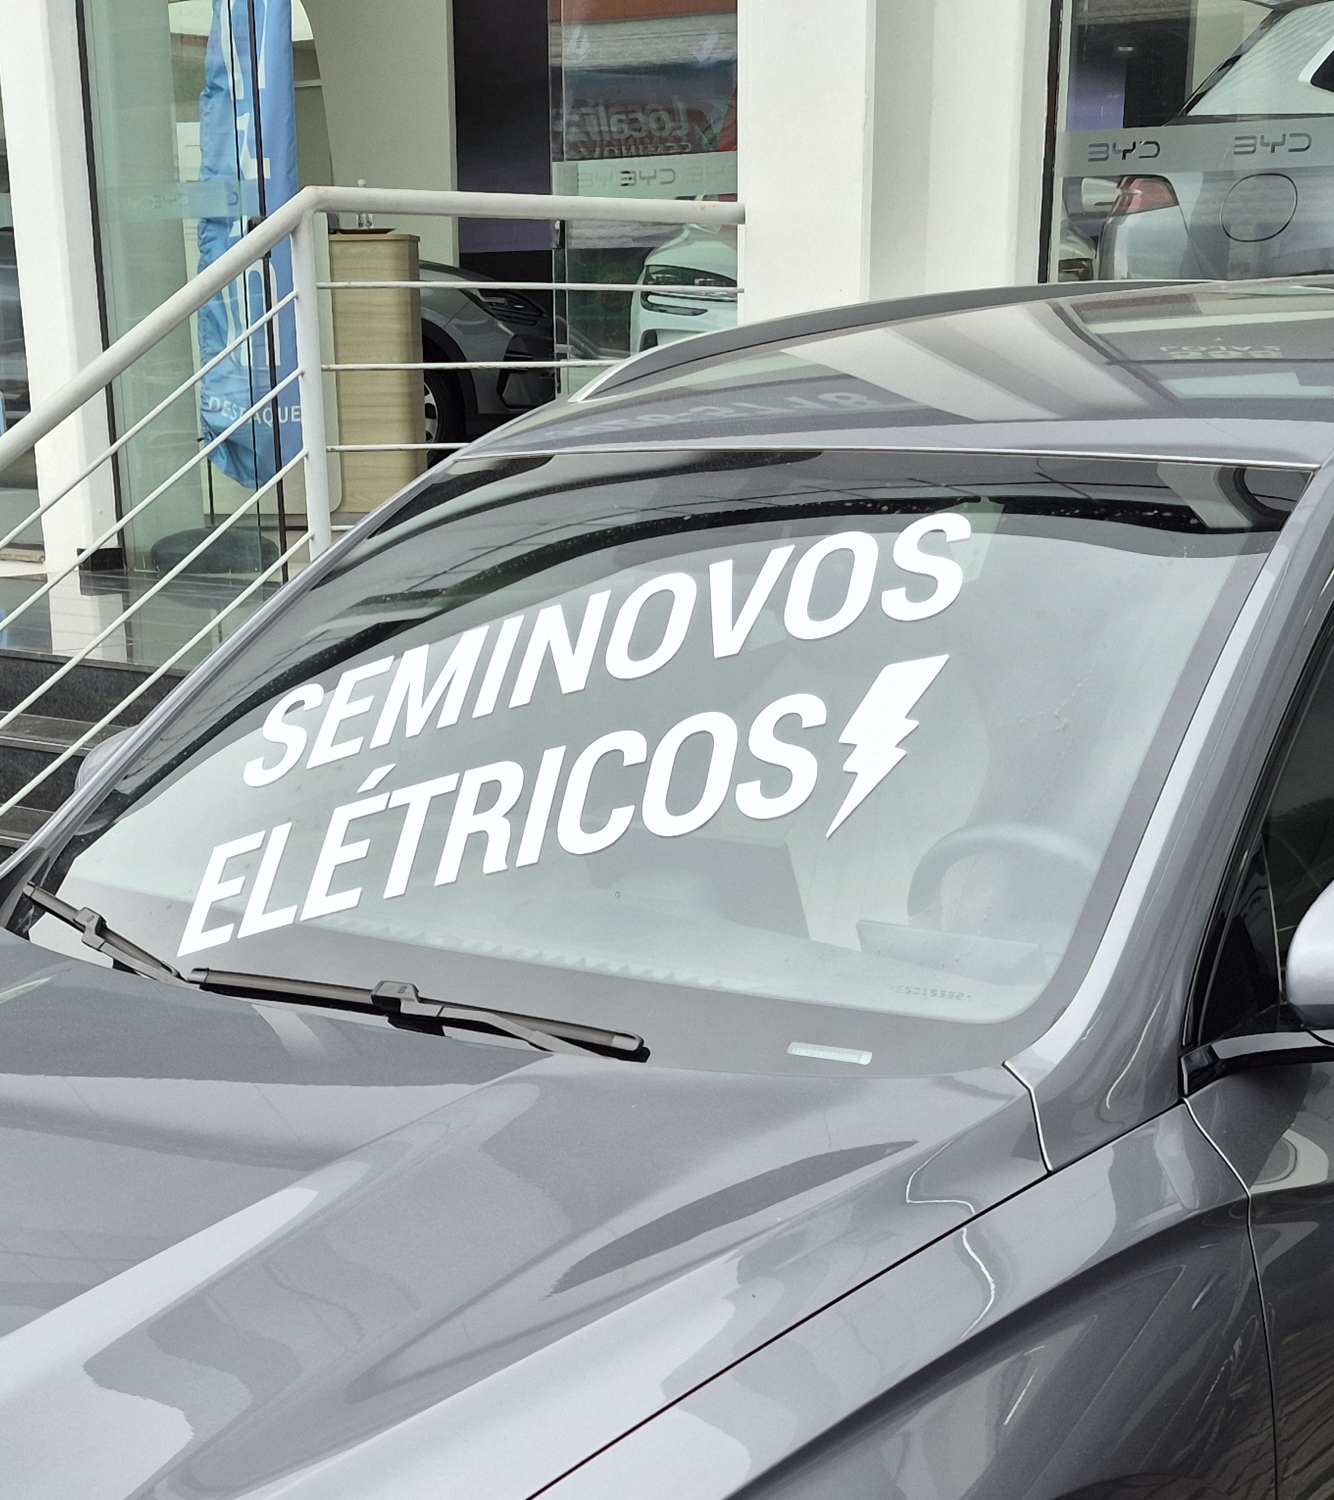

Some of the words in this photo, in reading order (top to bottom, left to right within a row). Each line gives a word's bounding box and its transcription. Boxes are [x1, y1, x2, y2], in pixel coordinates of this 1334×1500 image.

[1088, 141, 1161, 162] BYD
[1233, 132, 1312, 155] BYD
[620, 168, 676, 187] BYD
[208, 396, 303, 427] DESTAQUE
[242, 511, 971, 788] SEMINOVOS
[177, 693, 827, 957] ELÉTRICOS
